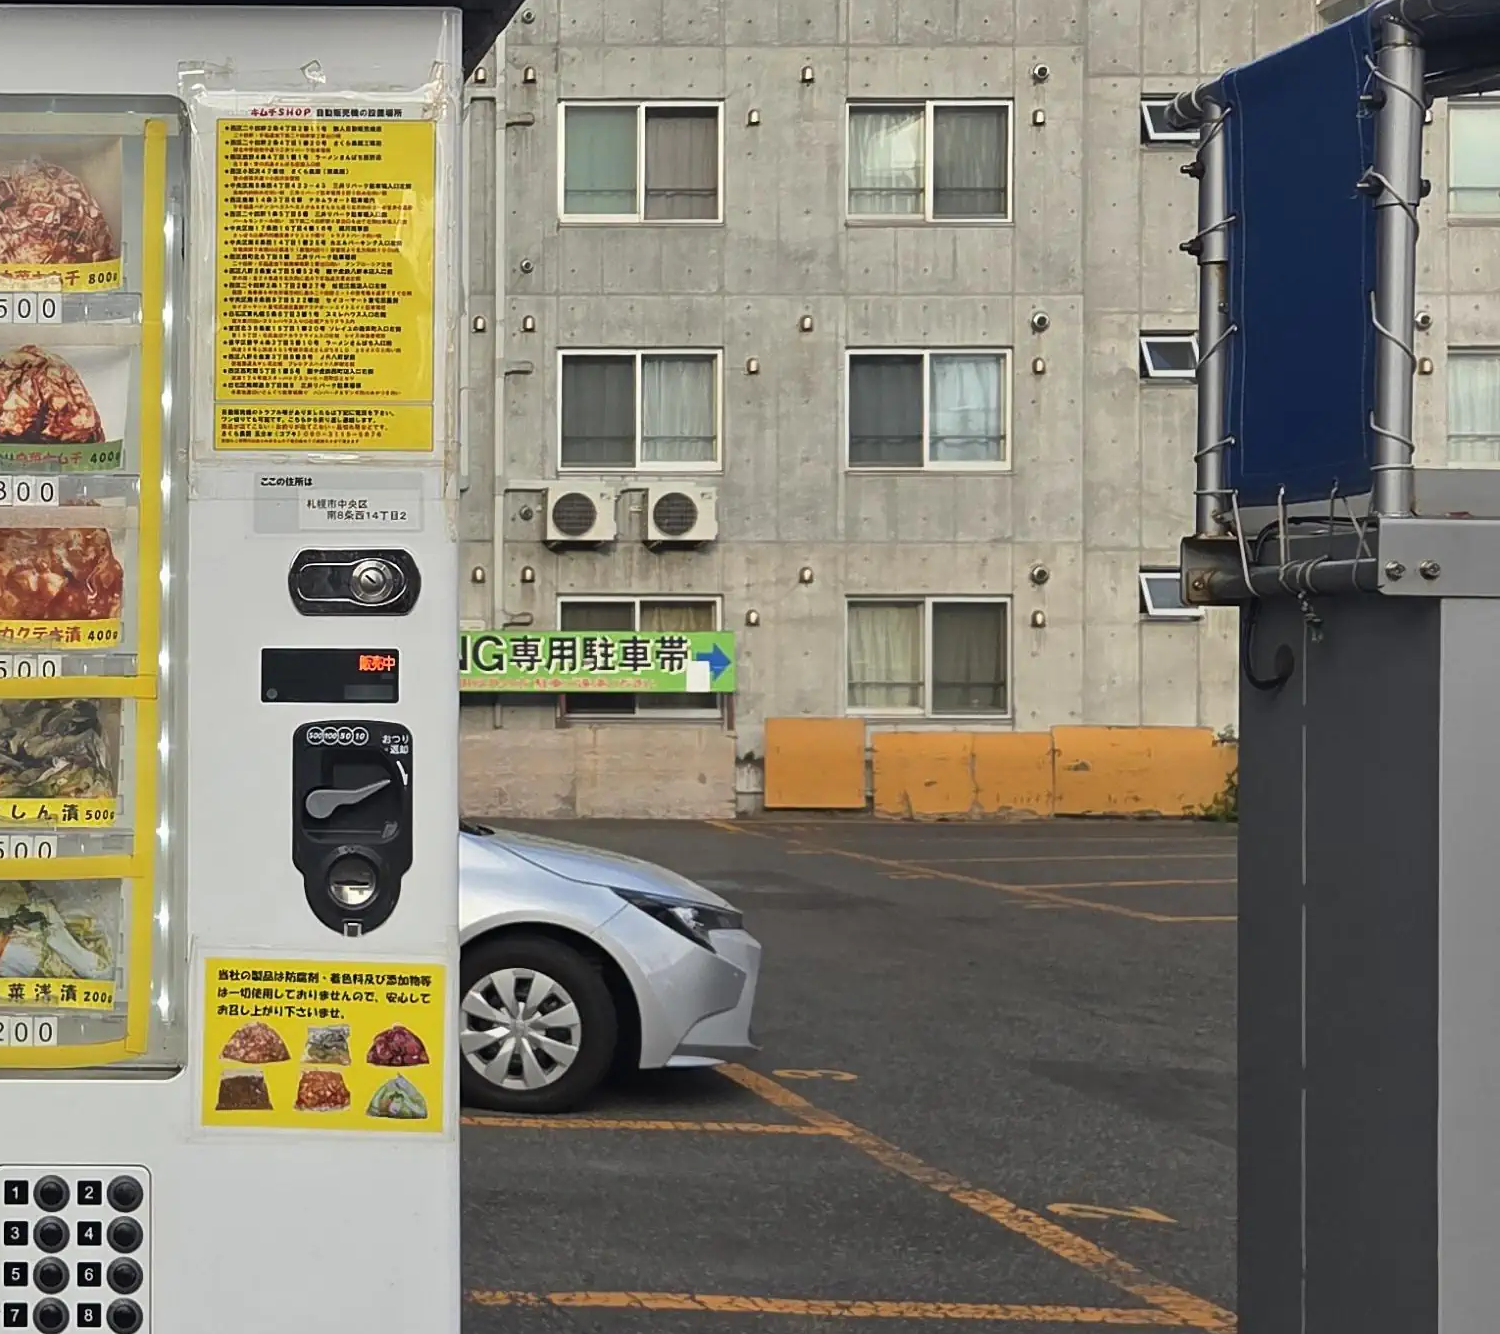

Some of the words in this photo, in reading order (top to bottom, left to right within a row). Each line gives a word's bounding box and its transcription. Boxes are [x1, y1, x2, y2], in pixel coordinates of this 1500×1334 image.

[260, 477, 313, 487] ここの住所は
[306, 499, 368, 509] 札幌市中央区
[382, 734, 409, 744] おつり
[218, 970, 432, 987] 当社の製品は防腐剤・着色料及び添加物等
[217, 1004, 345, 1019] お召し上がり下さいませ。
[12, 1186, 19, 1199] 1
[84, 1186, 94, 1199] 2
[10, 1227, 20, 1240] 3
[84, 1227, 94, 1240] 4
[11, 1268, 20, 1281] 5
[84, 1268, 94, 1281] 6
[10, 1309, 20, 1322] 7
[84, 1309, 93, 1322] 8
